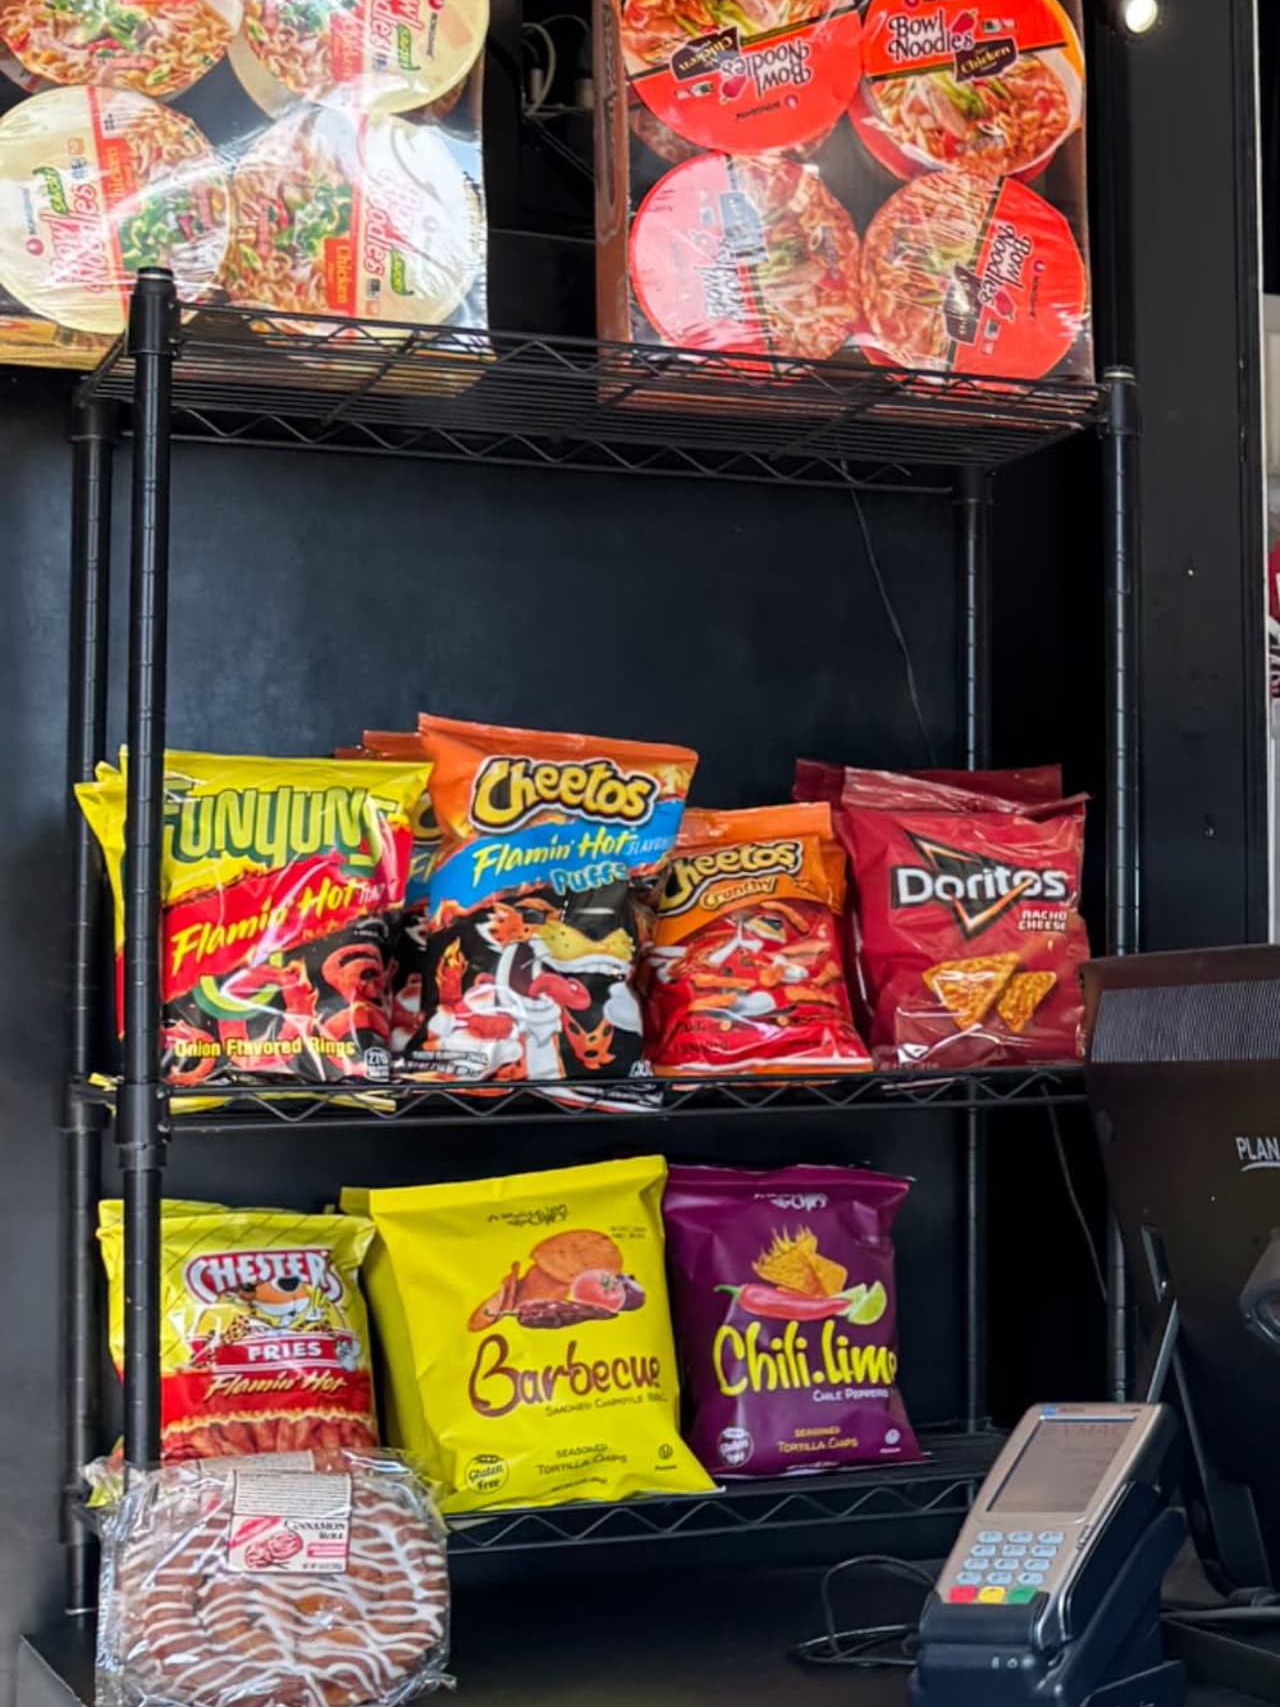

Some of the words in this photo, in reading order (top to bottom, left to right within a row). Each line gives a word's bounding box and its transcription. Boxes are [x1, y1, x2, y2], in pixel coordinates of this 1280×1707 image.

[888, 9, 944, 37] Bowl
[678, 36, 734, 72] Chicken
[720, 40, 811, 76] Noodles
[888, 32, 974, 61] Noodles
[960, 46, 1011, 73] Chicken
[756, 61, 812, 98] Bowl
[981, 224, 1014, 304] Noodles
[1006, 235, 1032, 289] Bowl
[472, 758, 655, 826] Cheetos
[472, 835, 575, 889] Flamin'
[578, 825, 630, 861] Hot
[551, 860, 631, 897] Puffs
[700, 875, 777, 911] Crunchy
[897, 865, 1068, 906] Doritos
[298, 877, 358, 919] Hot
[1021, 909, 1068, 922] NACHO
[1018, 919, 1068, 932] CHEESE
[174, 1040, 221, 1058] Onion
[225, 1037, 302, 1057] Flavored
[310, 1036, 357, 1059] Rings
[246, 1339, 323, 1364] FRIES
[204, 1372, 299, 1402] Flamin'
[301, 1374, 349, 1396] Hot
[468, 1334, 661, 1419] Barbecue
[813, 1390, 843, 1402] CHILE
[776, 1439, 825, 1453] TORTILLA
[828, 1436, 859, 1449] CHIPS
[468, 1464, 504, 1482] Gluten
